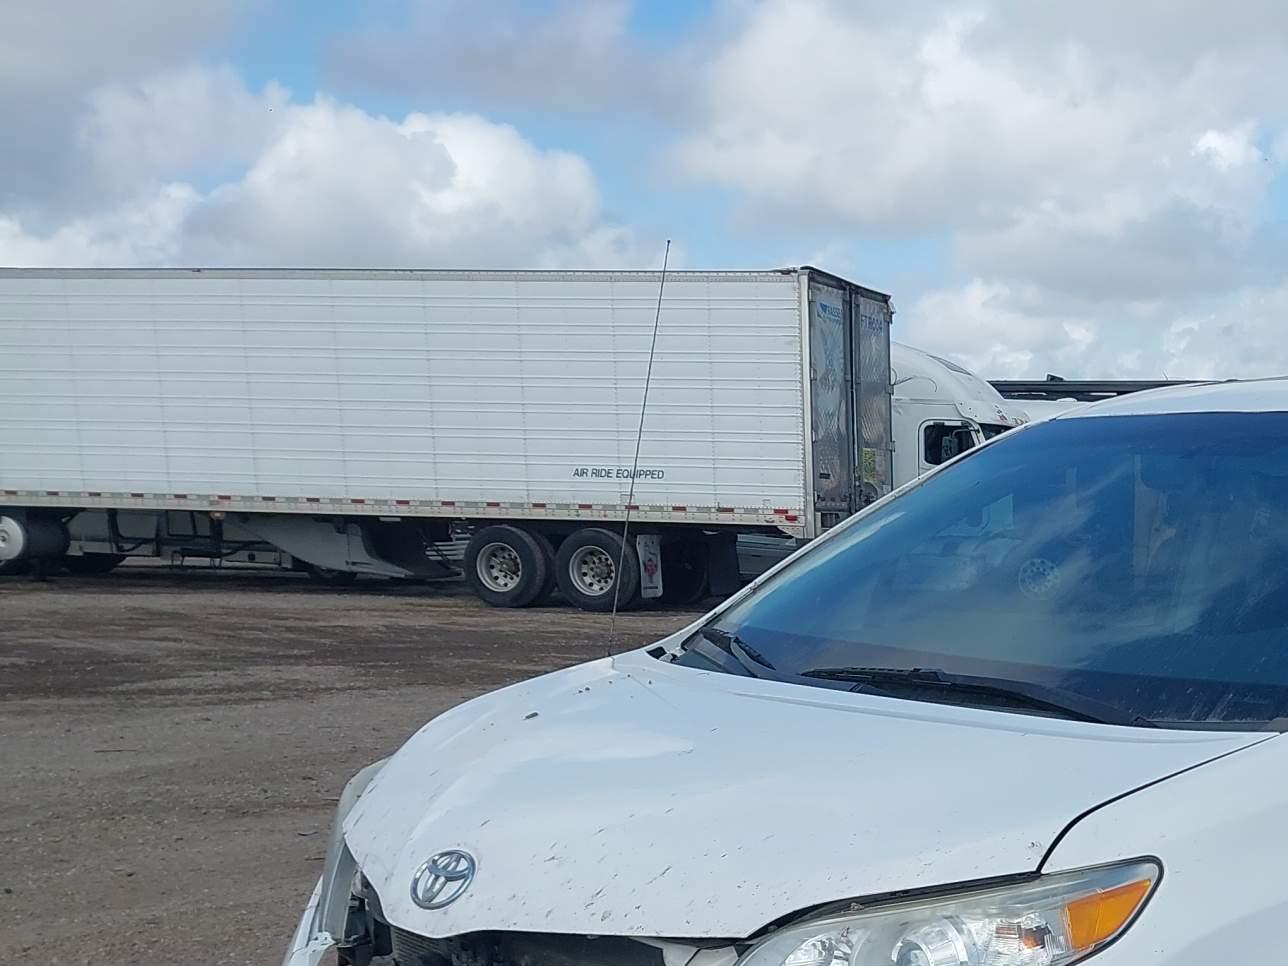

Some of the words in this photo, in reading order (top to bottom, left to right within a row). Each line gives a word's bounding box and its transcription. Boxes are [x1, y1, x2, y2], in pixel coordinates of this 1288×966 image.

[572, 467, 589, 478] AIR
[590, 468, 614, 479] RIDE
[615, 468, 665, 480] EQUIPPED
